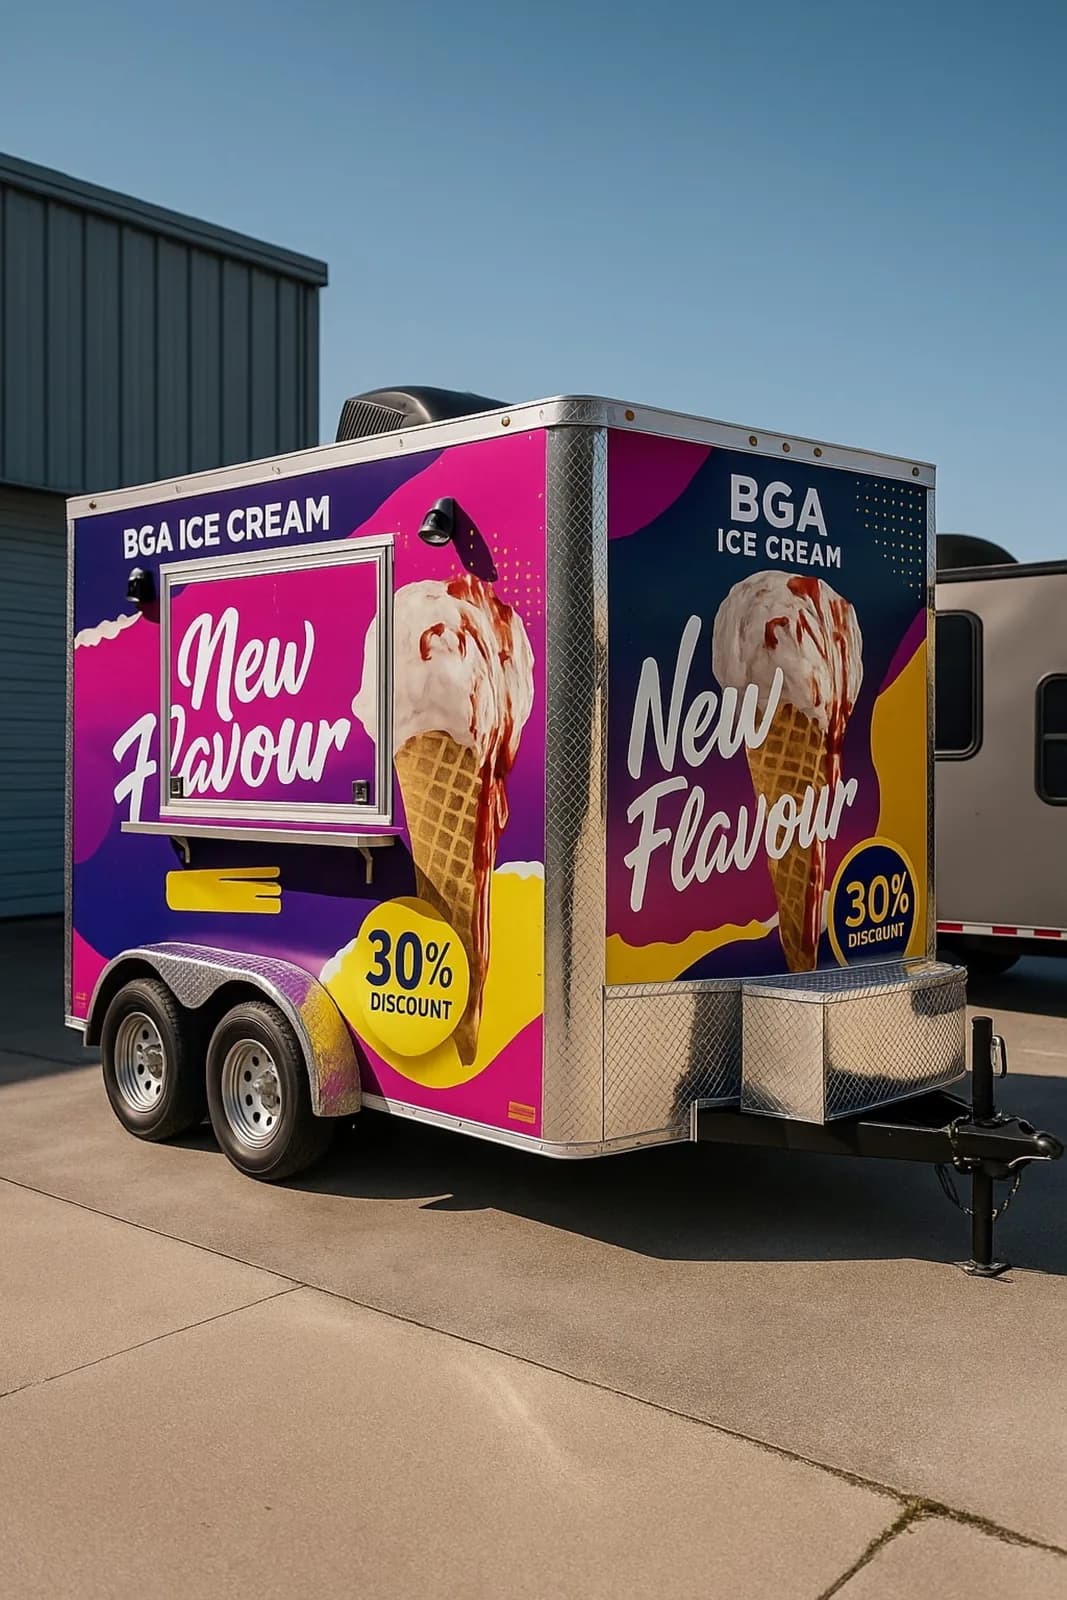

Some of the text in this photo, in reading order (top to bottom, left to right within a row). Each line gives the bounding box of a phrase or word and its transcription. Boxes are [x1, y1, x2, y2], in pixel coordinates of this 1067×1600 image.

[123, 495, 330, 559] BGA ICE CREAM
[730, 473, 828, 537] BGA
[717, 528, 841, 568] ICE CREAM
[178, 607, 315, 722] New
[627, 615, 783, 779] New
[624, 775, 858, 912] Flavour
[845, 871, 910, 929] 30%
[366, 929, 453, 990] 30%
[370, 992, 452, 1020] DISCOUNT
